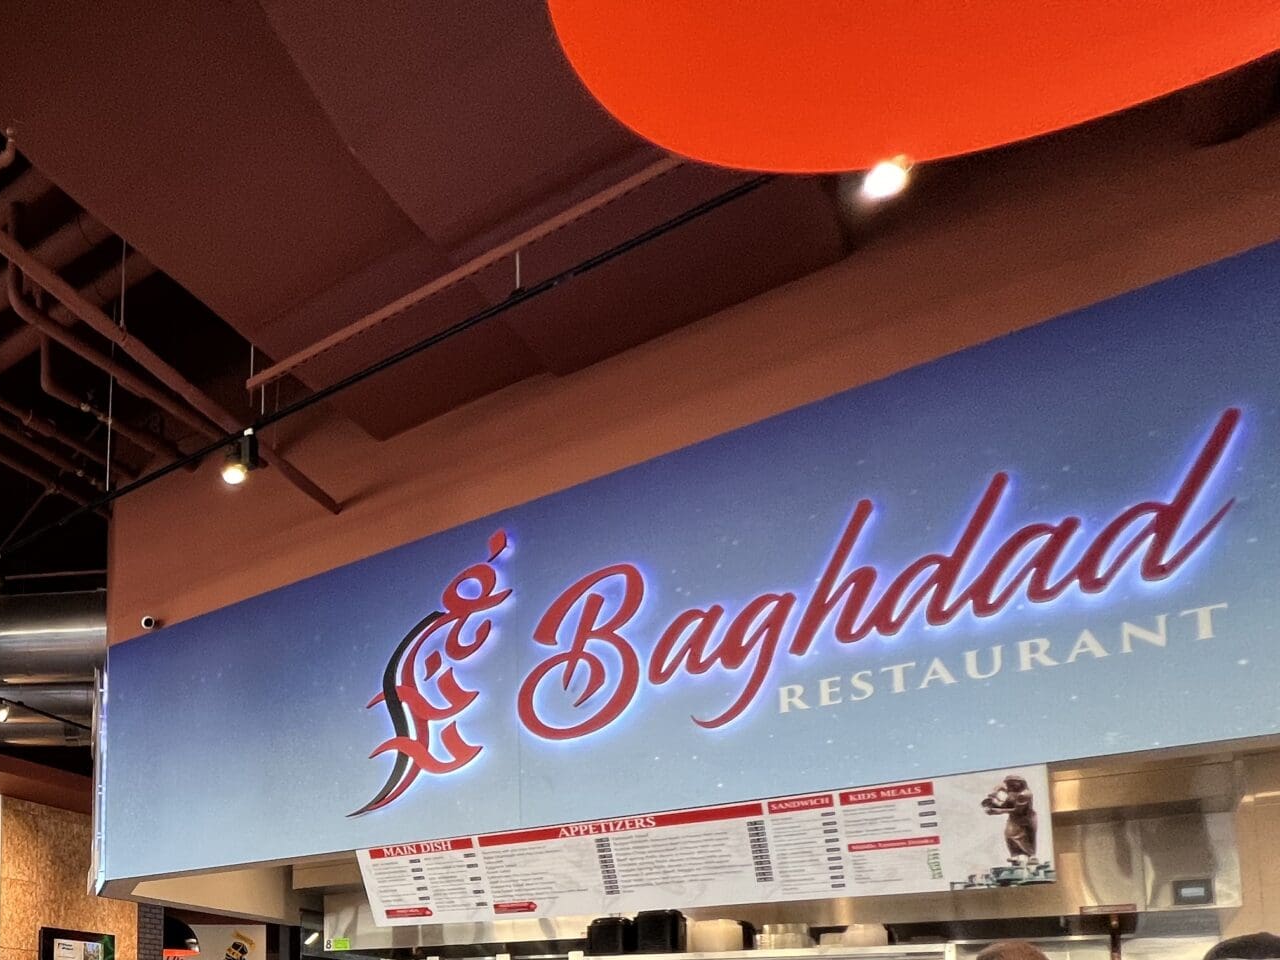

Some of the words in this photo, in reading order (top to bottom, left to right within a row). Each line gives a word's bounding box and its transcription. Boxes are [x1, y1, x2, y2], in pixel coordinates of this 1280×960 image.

[517, 407, 1238, 740] Baghdad
[778, 603, 1228, 713] RESTAURANT
[849, 792, 877, 802] KIDS
[880, 786, 922, 798] MEALS
[771, 796, 830, 811] SANDWICH
[559, 816, 657, 838] APPETIZERS
[382, 843, 417, 857] MAIN
[420, 841, 452, 853] DISH
[326, 939, 332, 950] 8
